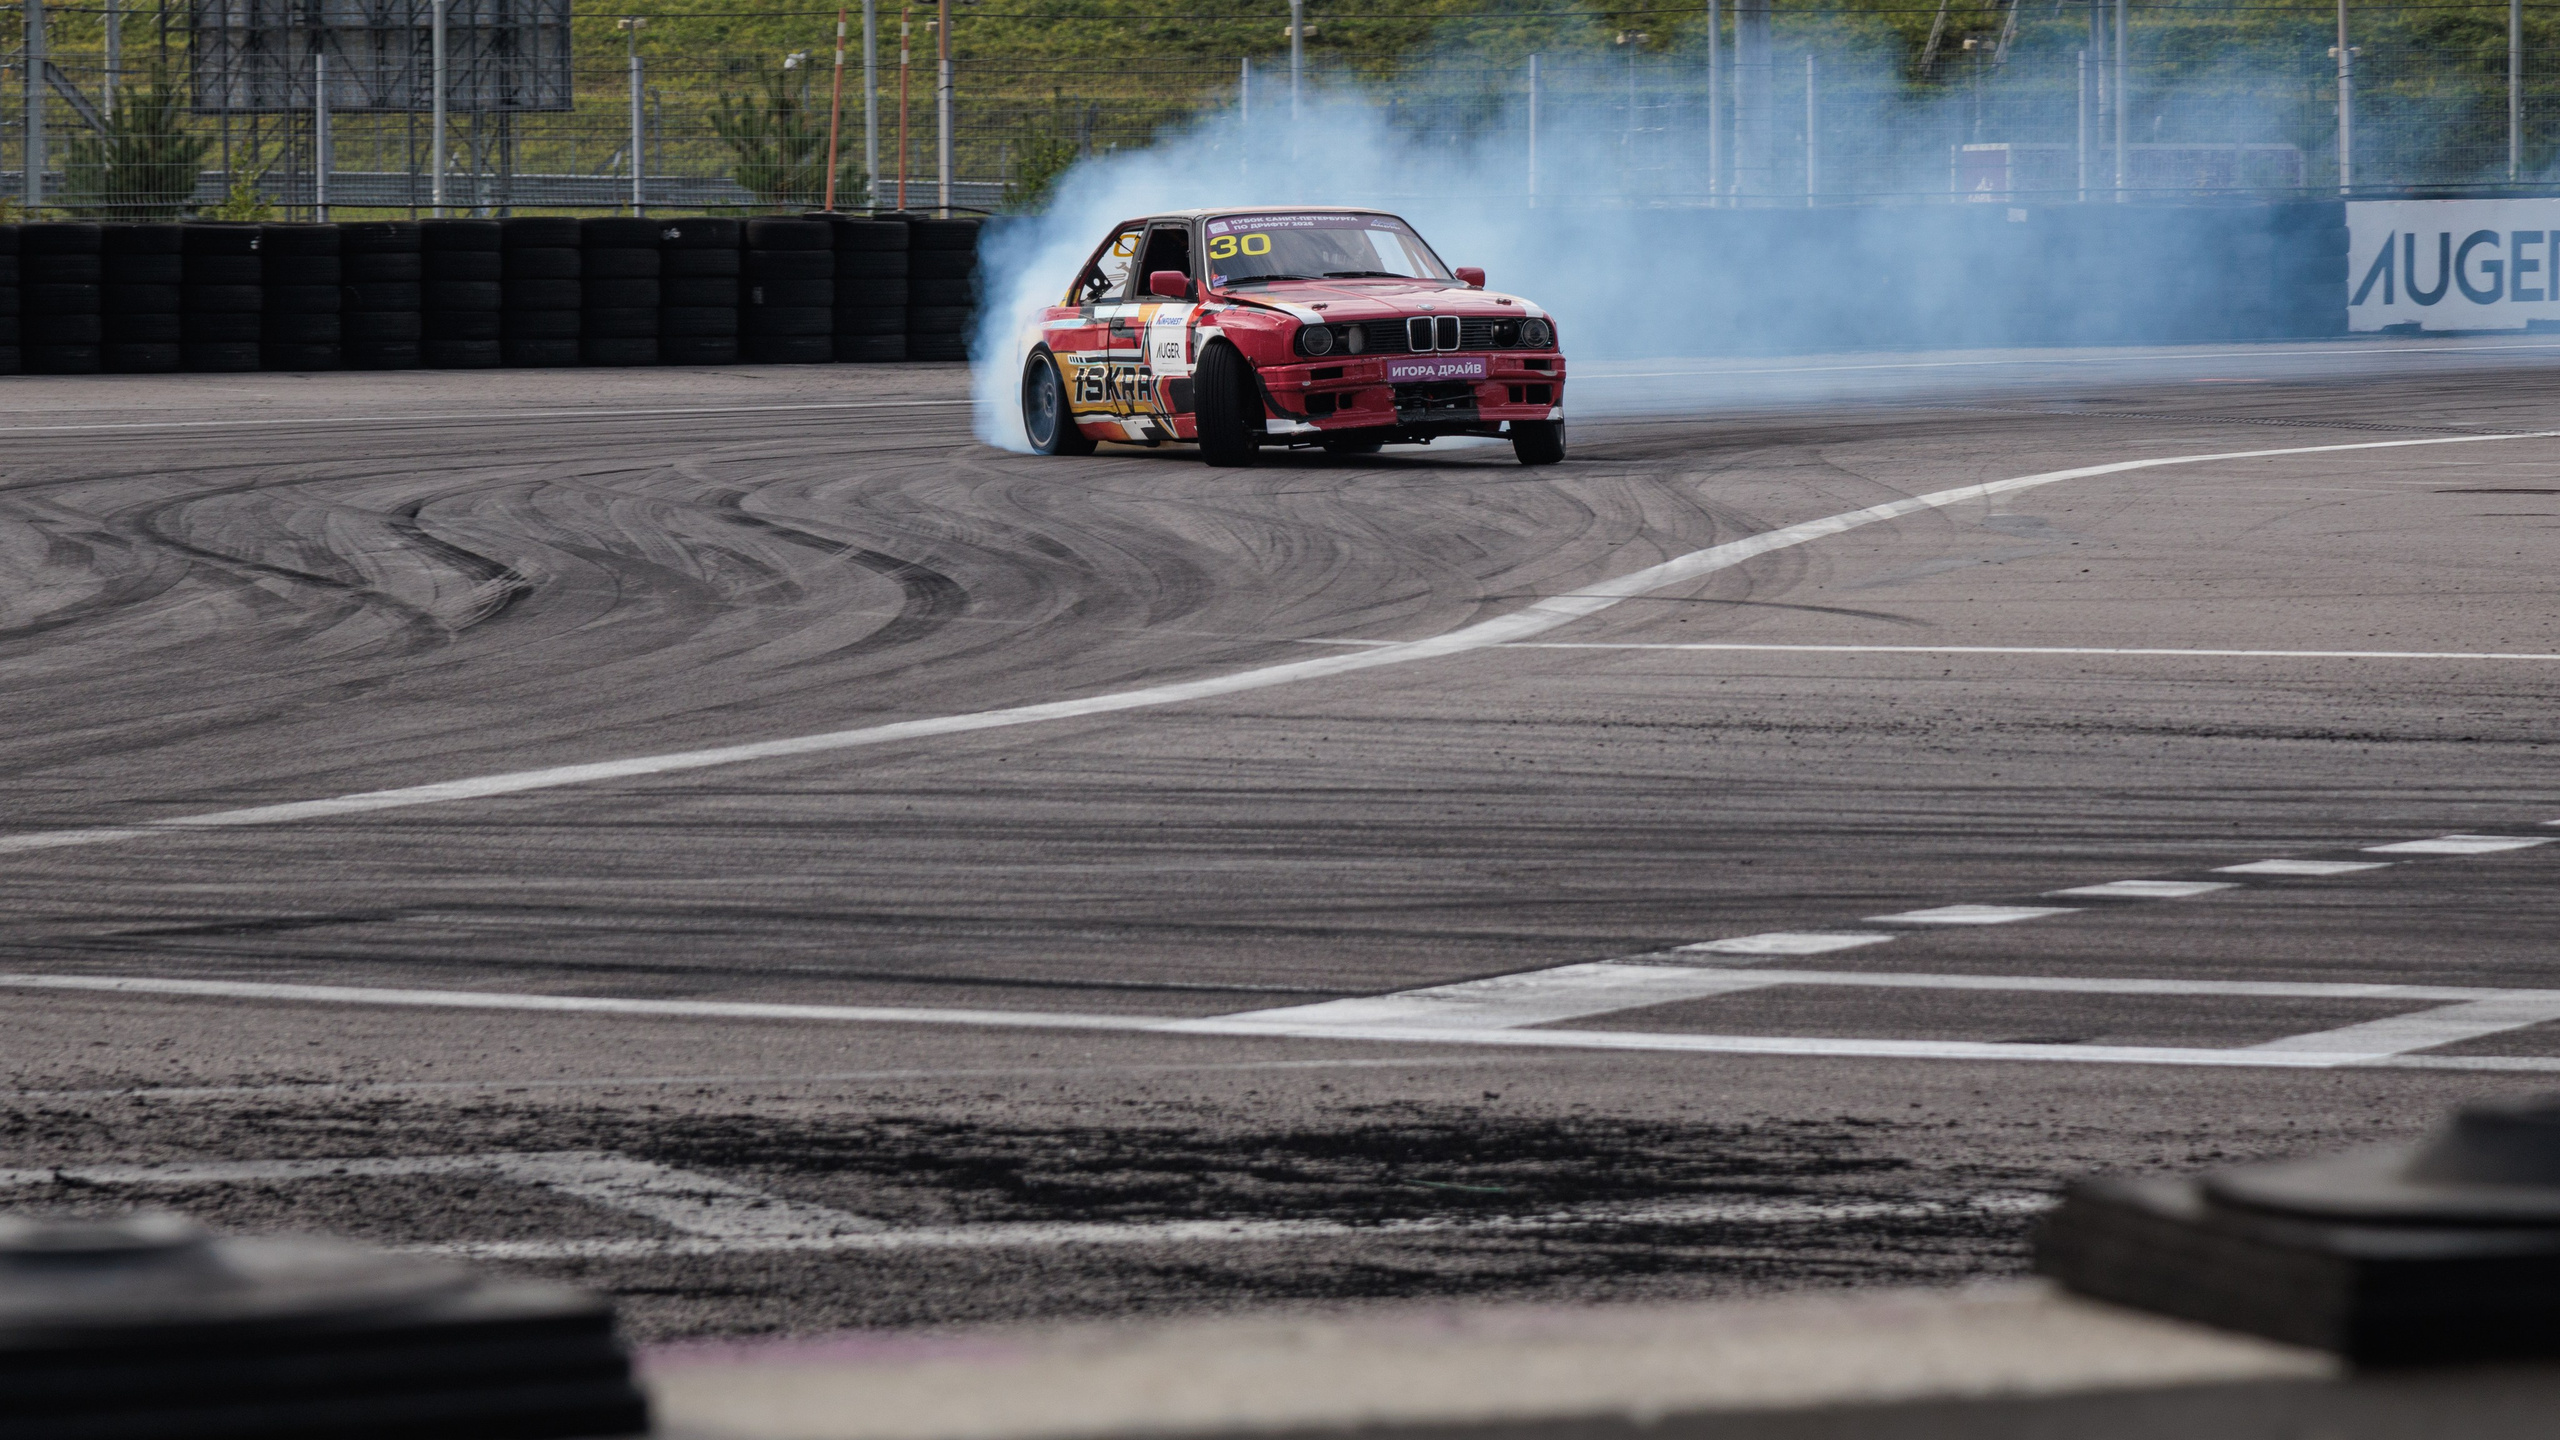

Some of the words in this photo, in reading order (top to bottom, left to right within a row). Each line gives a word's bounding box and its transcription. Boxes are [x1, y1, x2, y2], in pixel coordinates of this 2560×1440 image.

[1230, 217, 1264, 225] КУБОК
[1209, 233, 1271, 260] 30
[2350, 229, 2560, 307] AUGE
[1156, 342, 1180, 359] AUGER
[1392, 365, 1435, 377] ИГОРА
[1437, 362, 1482, 376] ДРАЙВ
[1074, 365, 1153, 404] ISKRA
